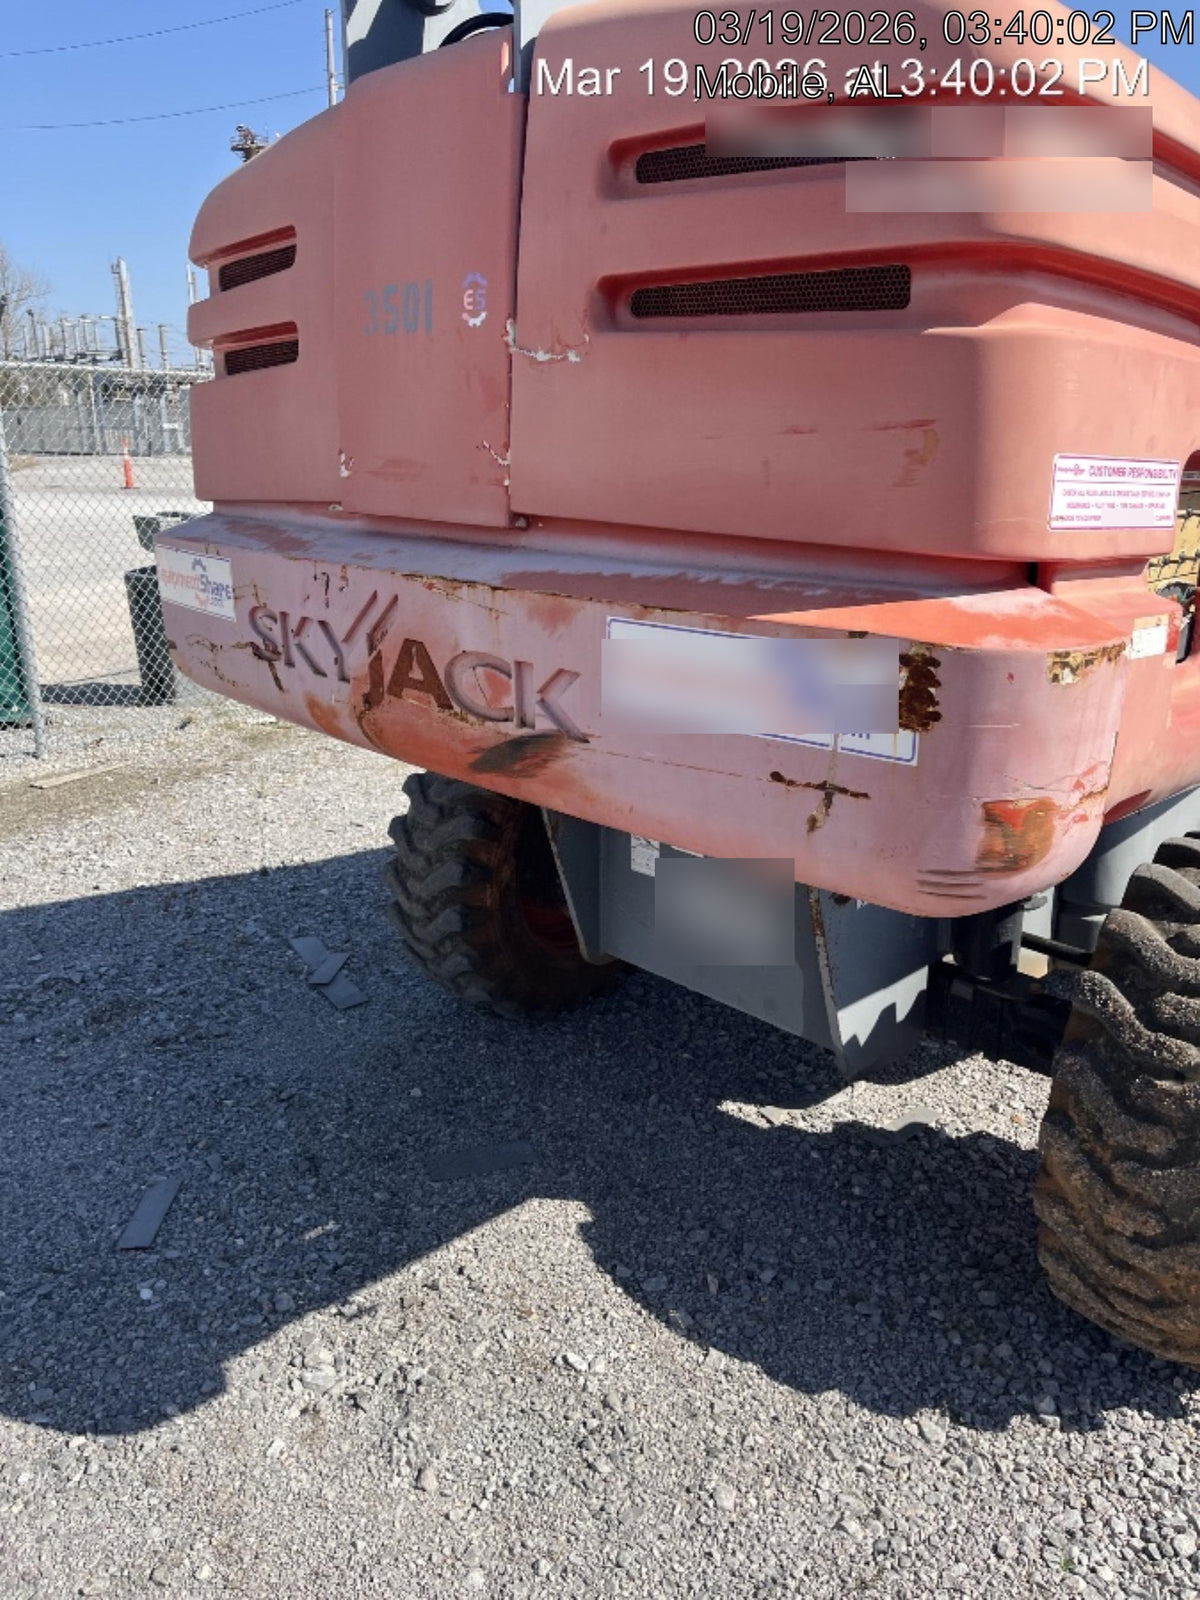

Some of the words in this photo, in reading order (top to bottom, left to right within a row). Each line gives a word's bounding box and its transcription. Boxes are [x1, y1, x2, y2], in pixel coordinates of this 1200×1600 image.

[363, 280, 433, 336] 3501
[1088, 464, 1127, 478] CUSTOMER
[247, 588, 590, 744] SKYJACK
